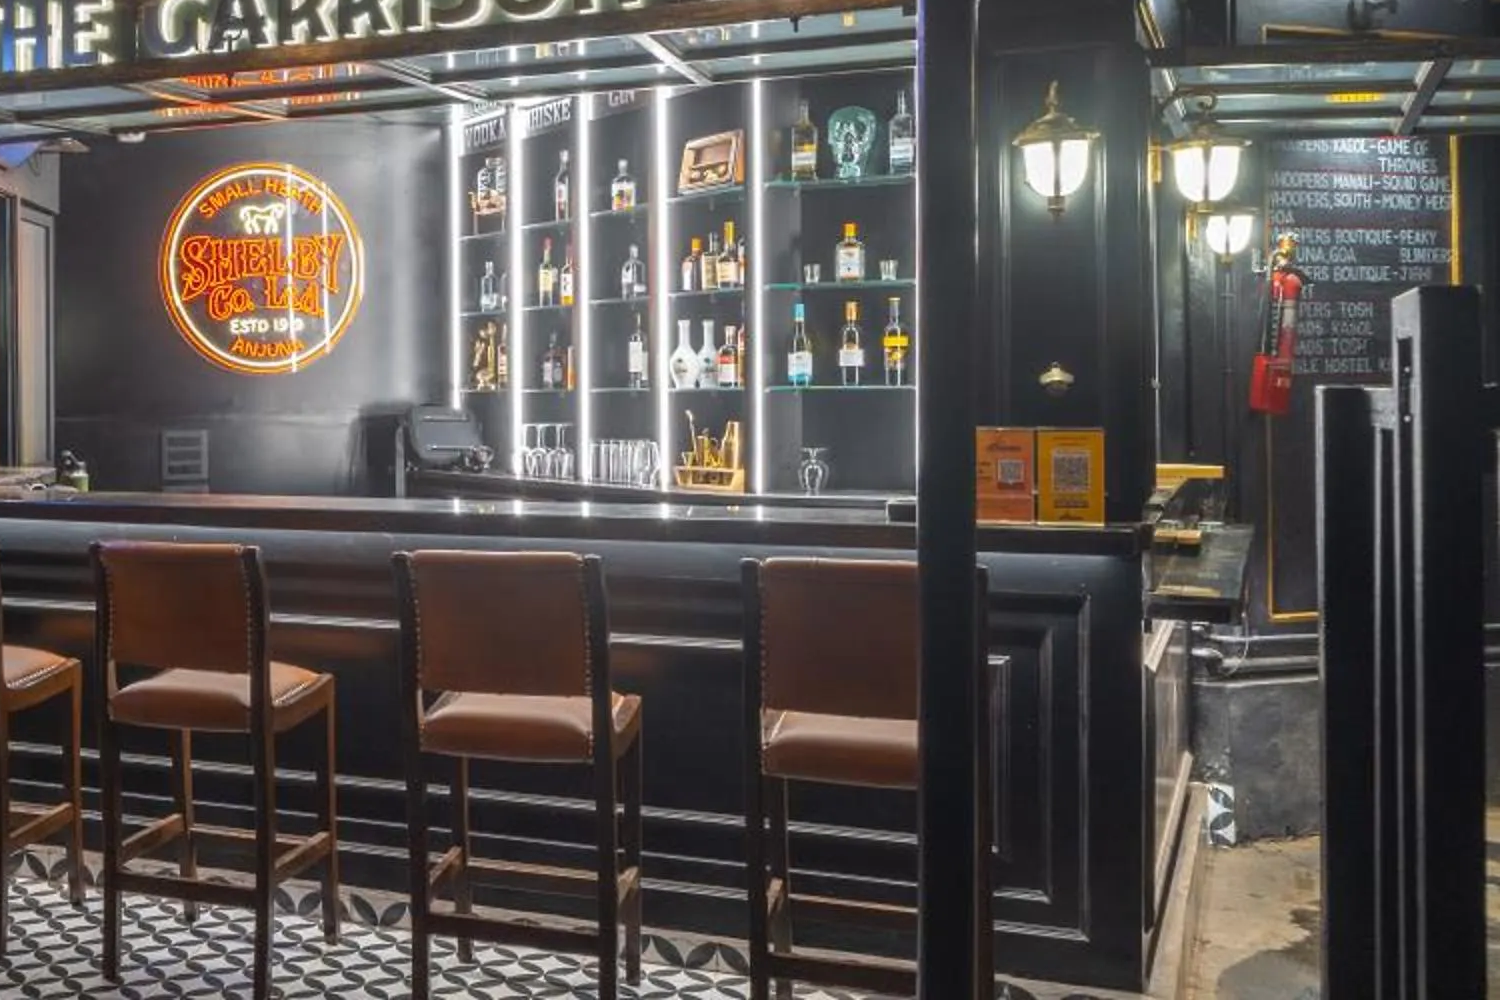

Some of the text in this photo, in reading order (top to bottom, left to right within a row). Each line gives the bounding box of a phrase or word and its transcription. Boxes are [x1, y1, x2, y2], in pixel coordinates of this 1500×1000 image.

[528, 97, 572, 130] HISKE
[465, 117, 507, 148] VODKA
[198, 178, 325, 219] SMALL HEATH
[180, 233, 345, 302] SHELBY
[1341, 301, 1374, 318] TOSH
[230, 319, 269, 334] ESTD
[1324, 356, 1372, 373] HOSTEL
